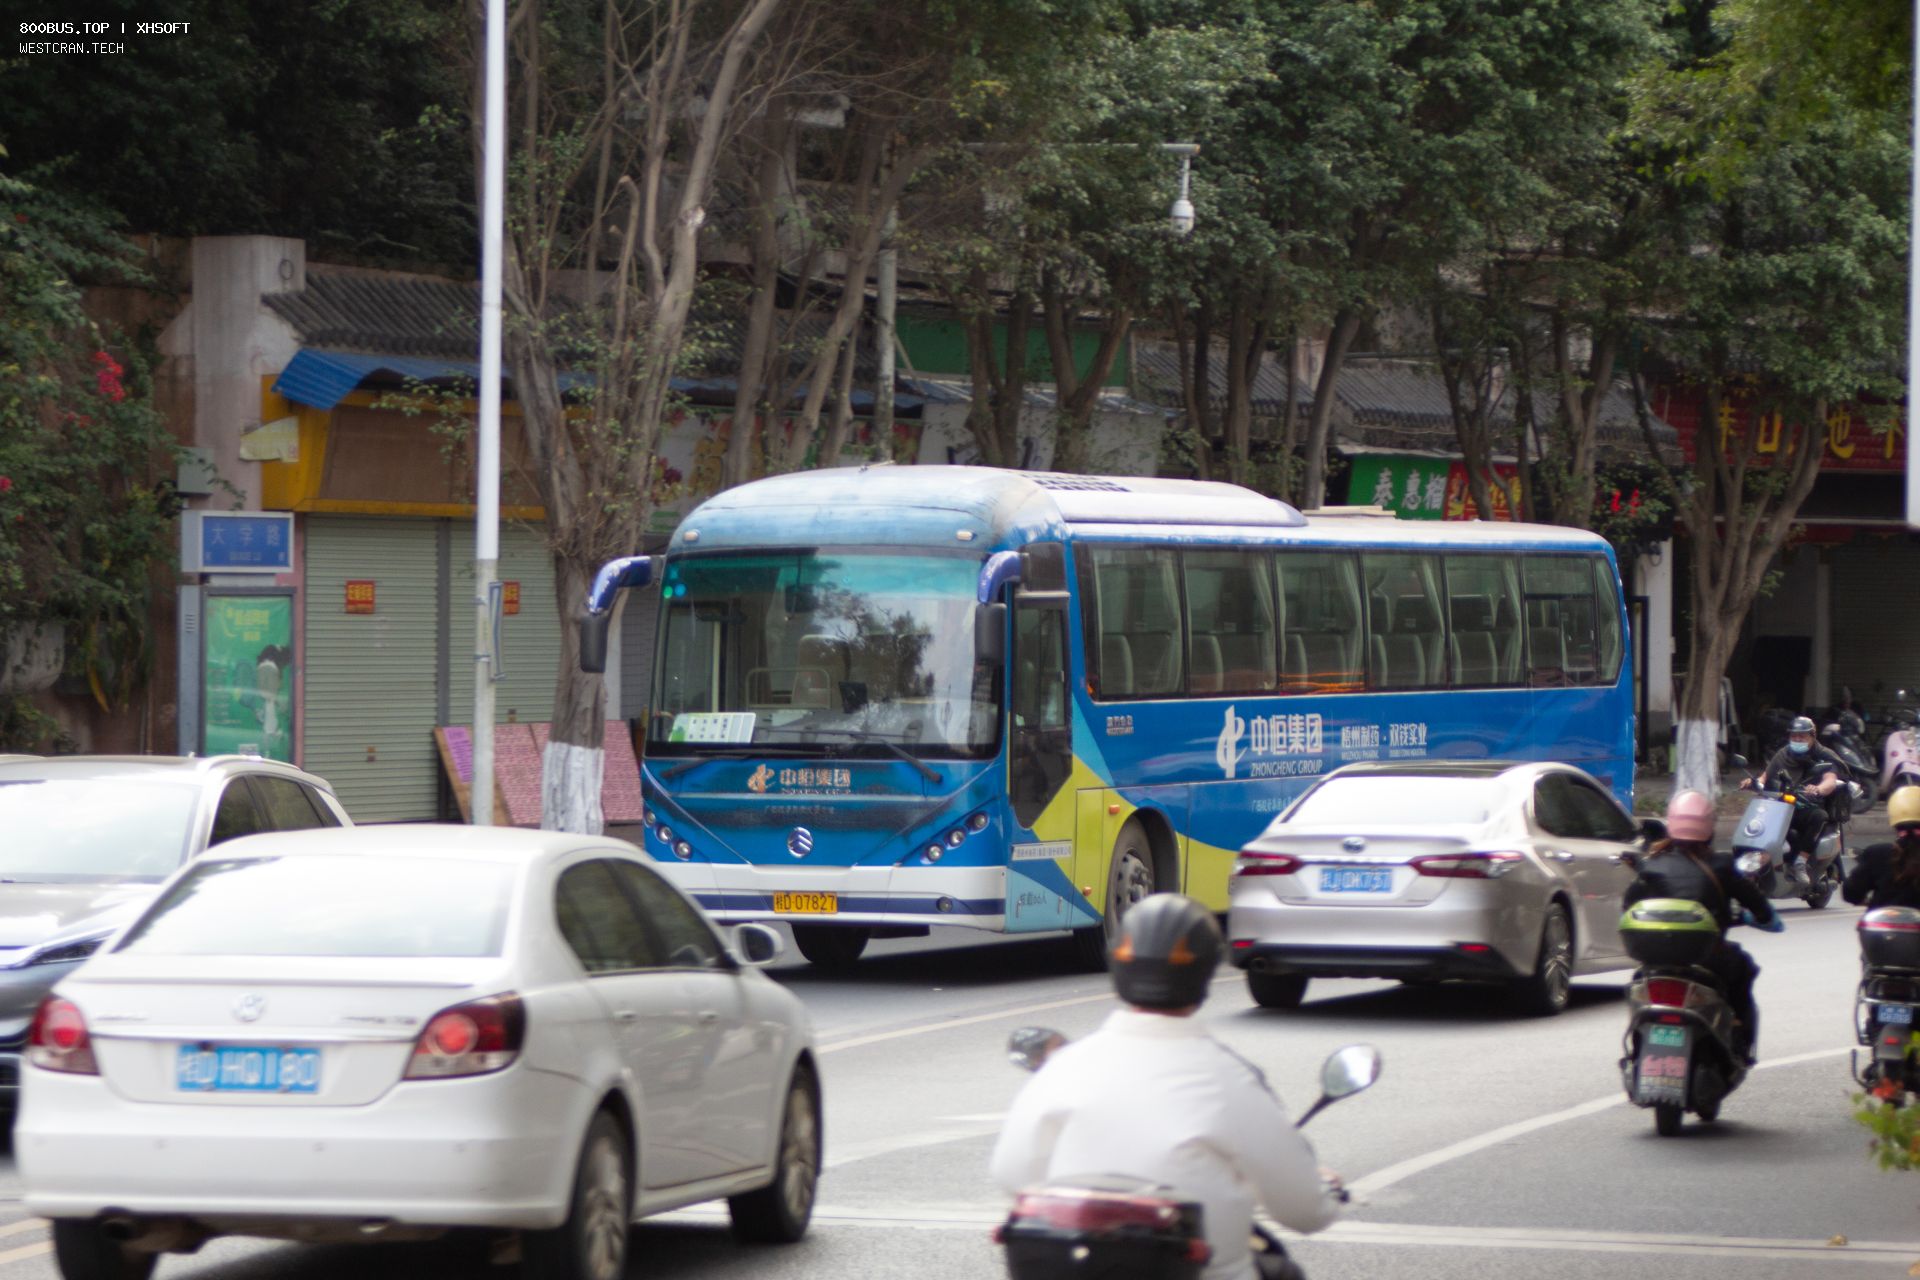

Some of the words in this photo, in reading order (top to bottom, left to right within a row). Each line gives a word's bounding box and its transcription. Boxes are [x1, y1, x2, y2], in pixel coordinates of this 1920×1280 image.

[1250, 713, 1323, 756] 中恒集团
[1250, 760, 1298, 777] ZHONGHENG
[1299, 759, 1323, 774] GROUP
